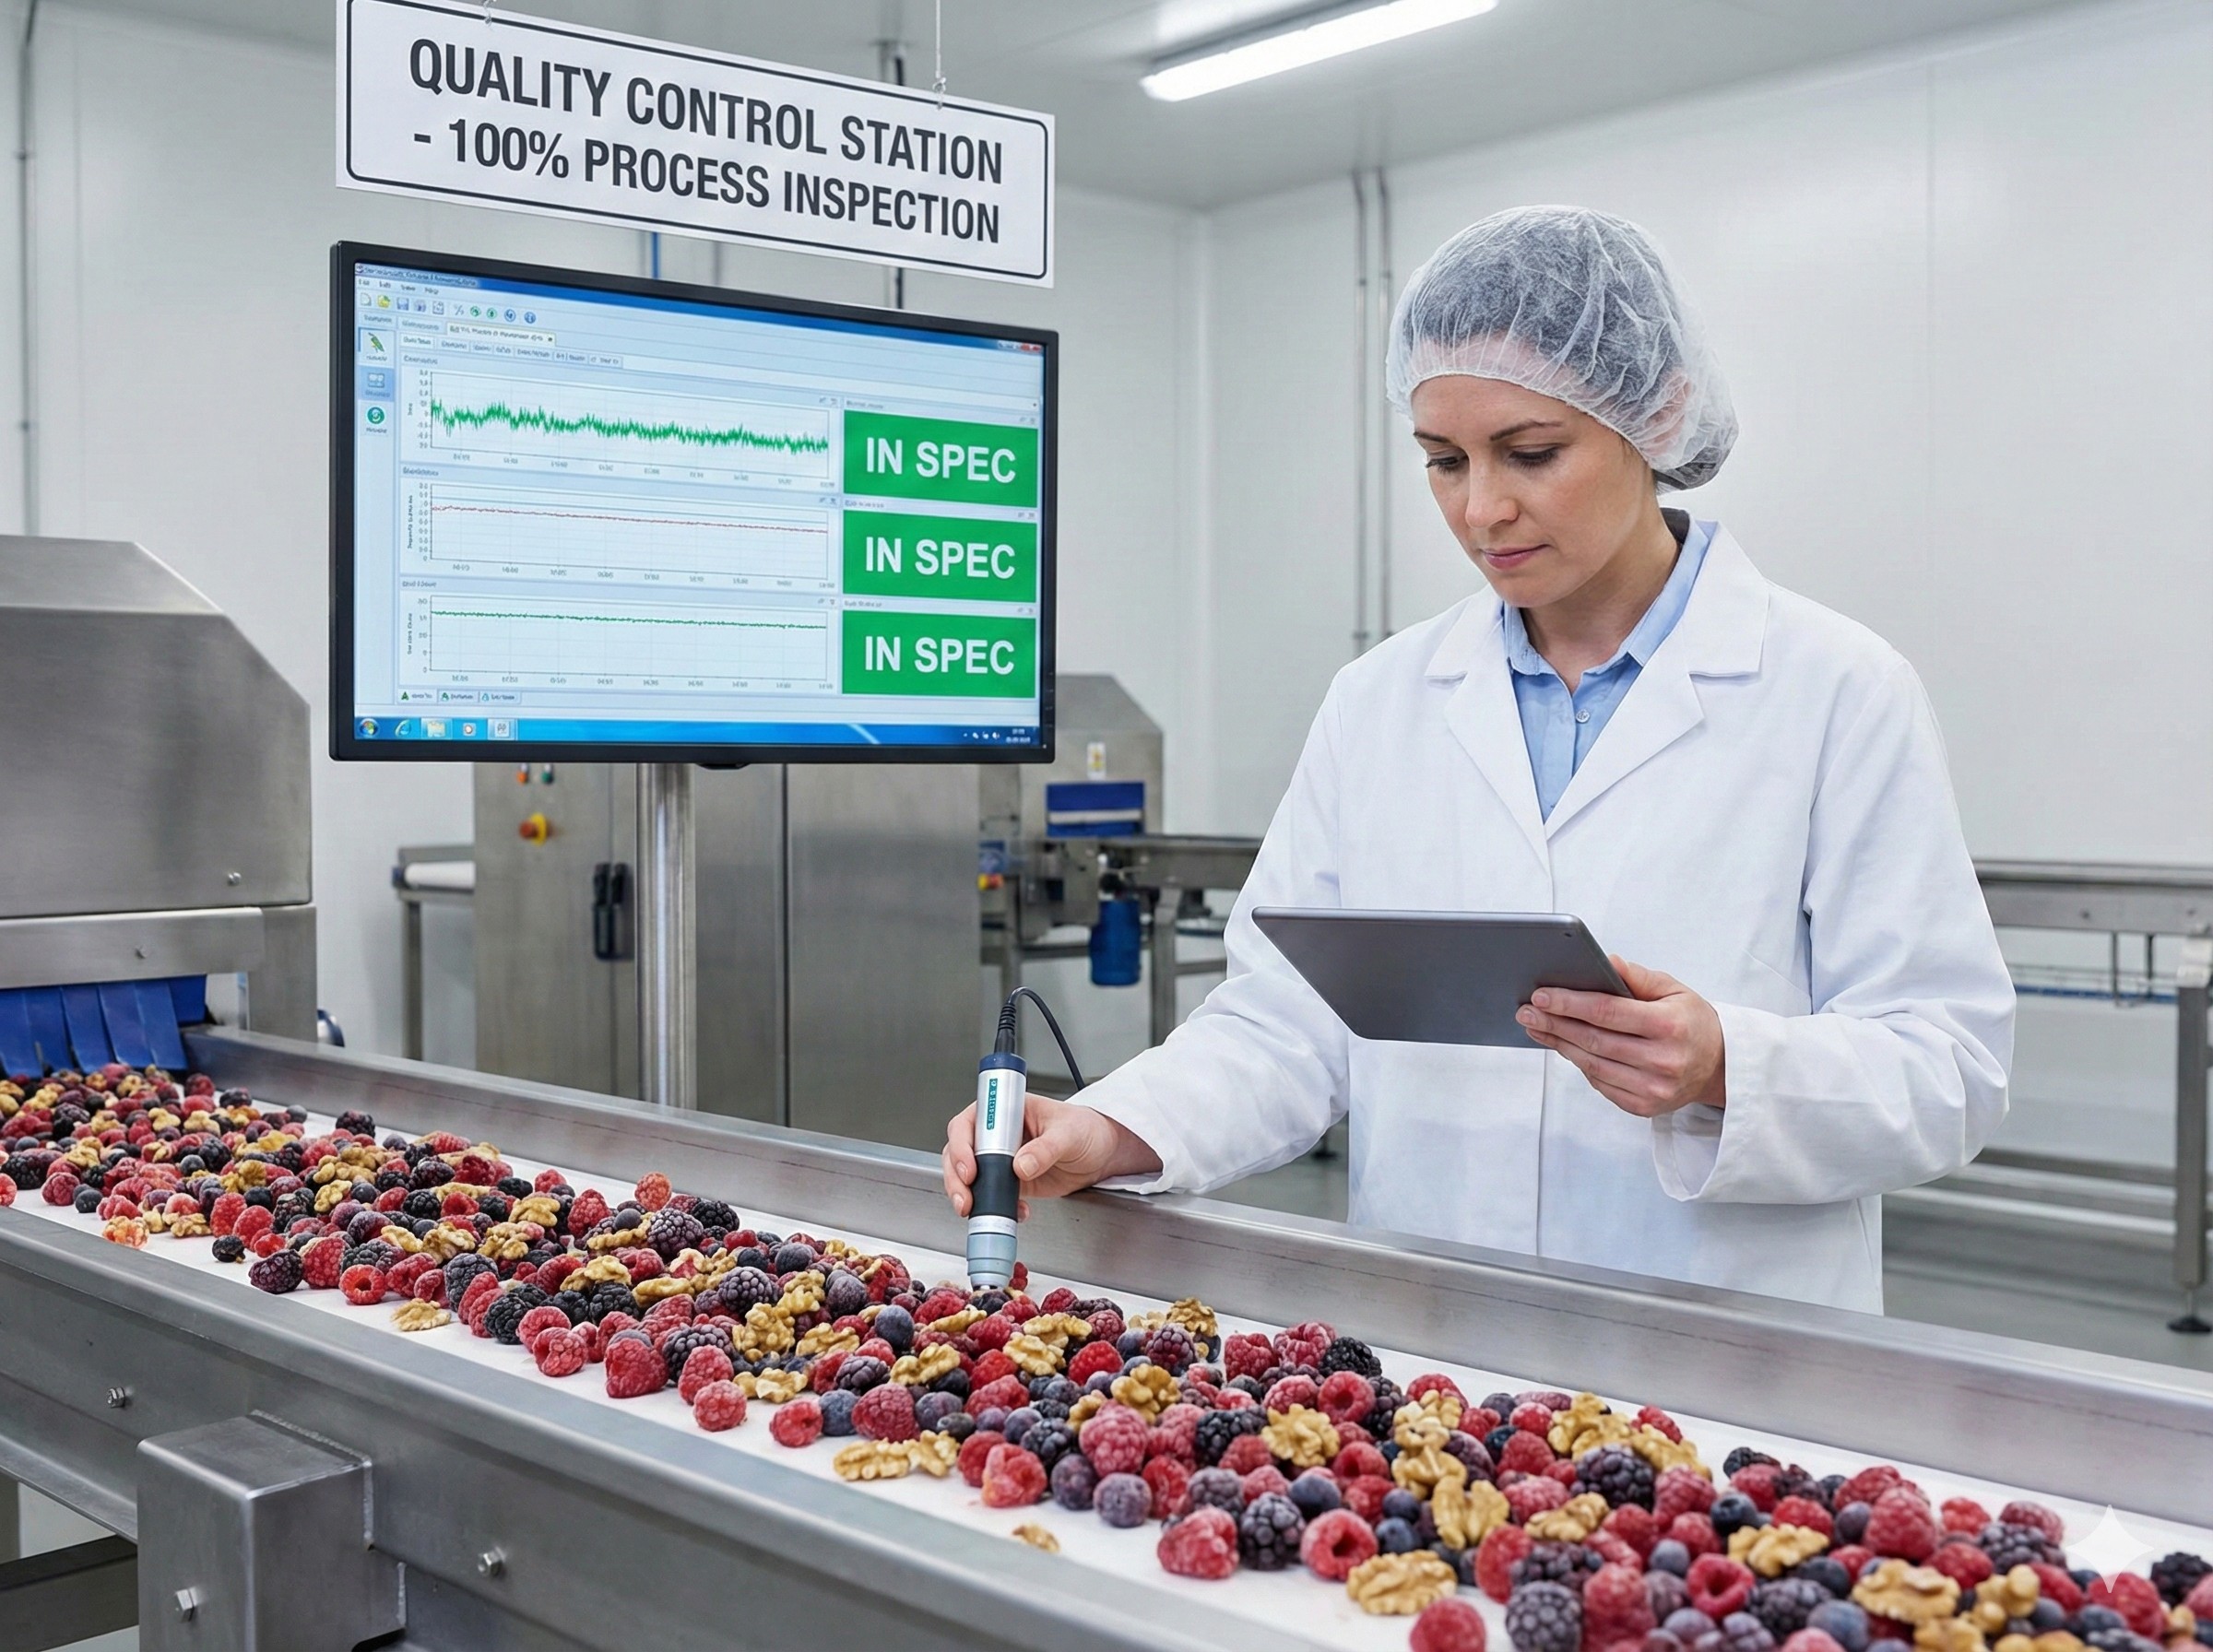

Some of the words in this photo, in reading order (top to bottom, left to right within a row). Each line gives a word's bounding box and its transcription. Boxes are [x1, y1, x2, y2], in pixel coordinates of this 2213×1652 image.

[409, 38, 611, 117] QUALITY
[627, 77, 827, 155] CONTROL
[841, 115, 1001, 184] STATION
[449, 118, 569, 179] 100%
[585, 138, 770, 208] PROCESS
[784, 171, 999, 243] INSPECTION
[866, 437, 903, 475] IN
[916, 442, 1016, 483] SPEC
[865, 537, 902, 573] IN
[915, 539, 1015, 579] SPEC
[865, 636, 901, 671] IN
[915, 637, 1014, 675] SPEC
